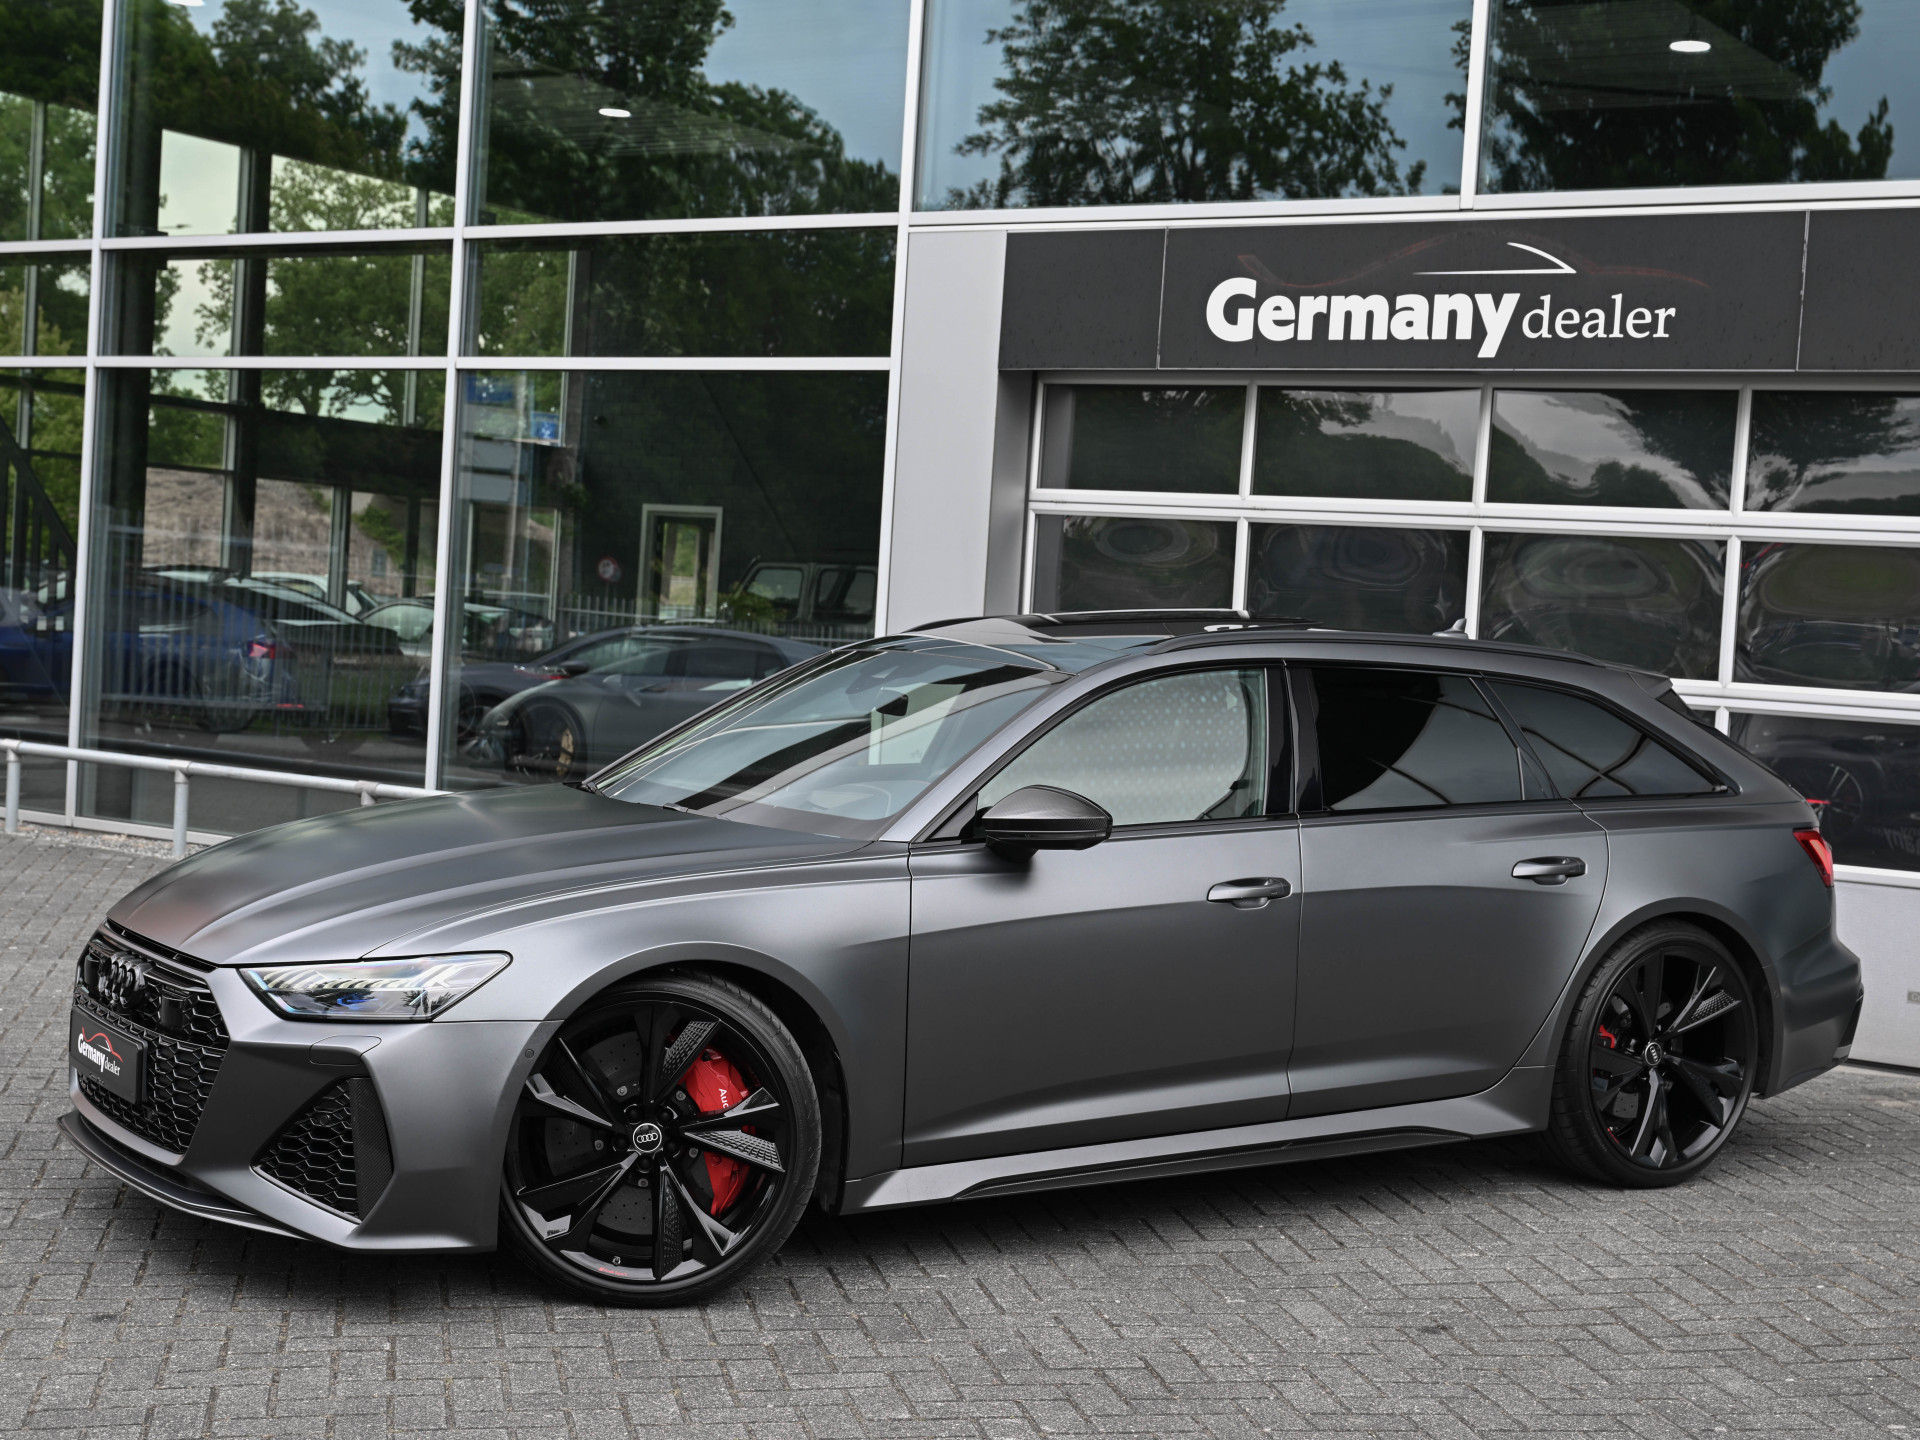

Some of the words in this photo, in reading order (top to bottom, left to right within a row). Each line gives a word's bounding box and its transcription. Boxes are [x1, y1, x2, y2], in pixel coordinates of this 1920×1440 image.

[1206, 277, 1521, 358] Germany
[1521, 293, 1676, 339] dealer
[78, 1033, 105, 1073] Germany
[104, 1056, 120, 1076] dealer
